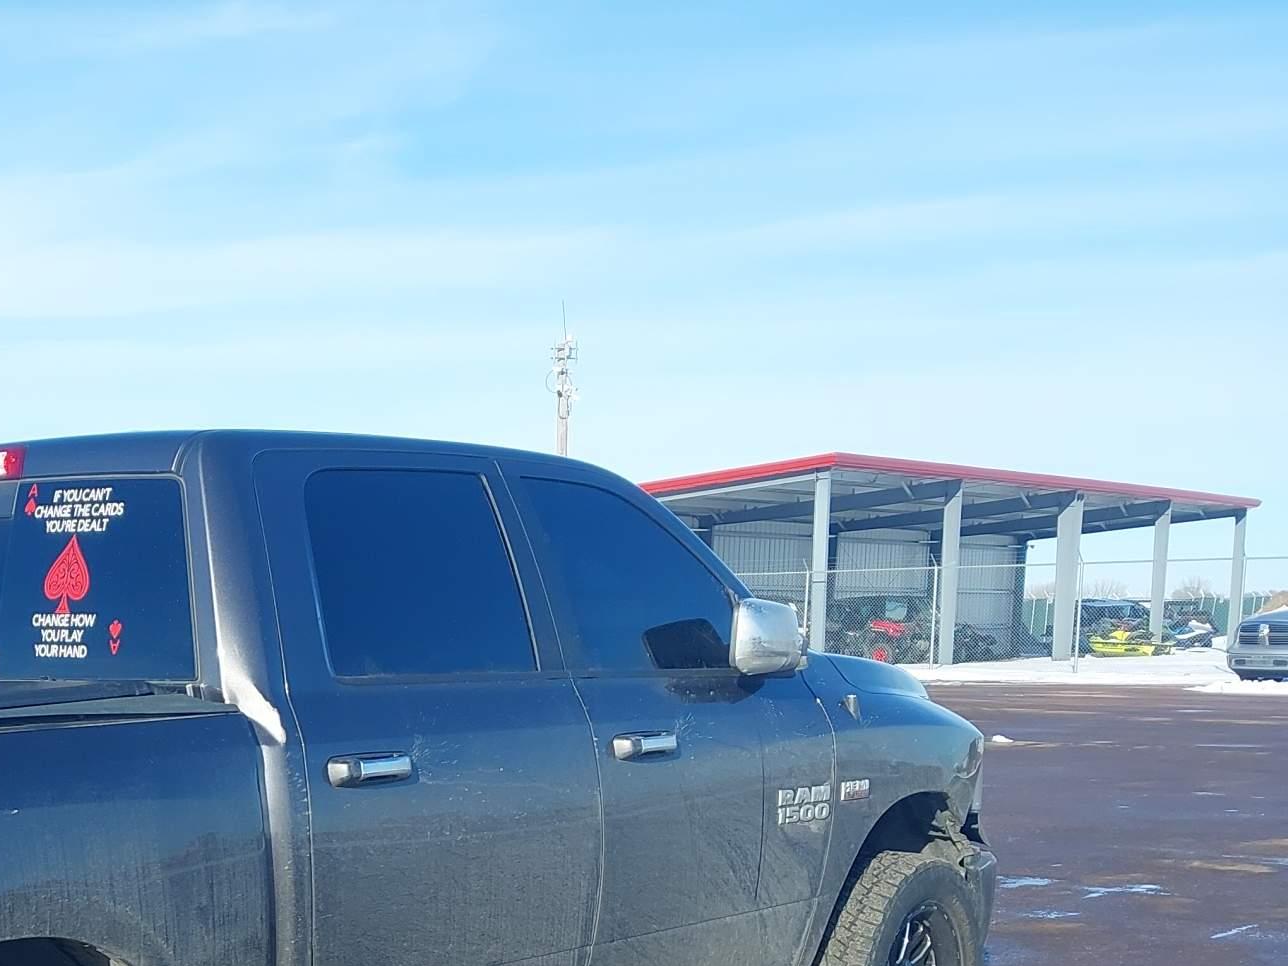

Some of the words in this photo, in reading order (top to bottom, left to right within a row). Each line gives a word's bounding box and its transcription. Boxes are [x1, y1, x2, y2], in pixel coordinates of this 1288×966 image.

[53, 489, 62, 503] IF
[63, 488, 82, 502] YOU
[82, 487, 112, 501] CAN'T
[34, 504, 72, 518] CHANGE
[73, 503, 91, 517] THE
[91, 502, 124, 516] CARDS
[46, 519, 77, 533] YOU'RE
[77, 518, 109, 532] DEALT
[32, 614, 70, 627] CHANGE
[70, 613, 96, 627] HOW
[41, 629, 60, 642] YOU
[60, 629, 84, 642] PLAY
[35, 644, 58, 657] YOUR
[58, 645, 87, 658] HAND
[778, 783, 831, 806] RAM
[777, 802, 830, 825] 1500
